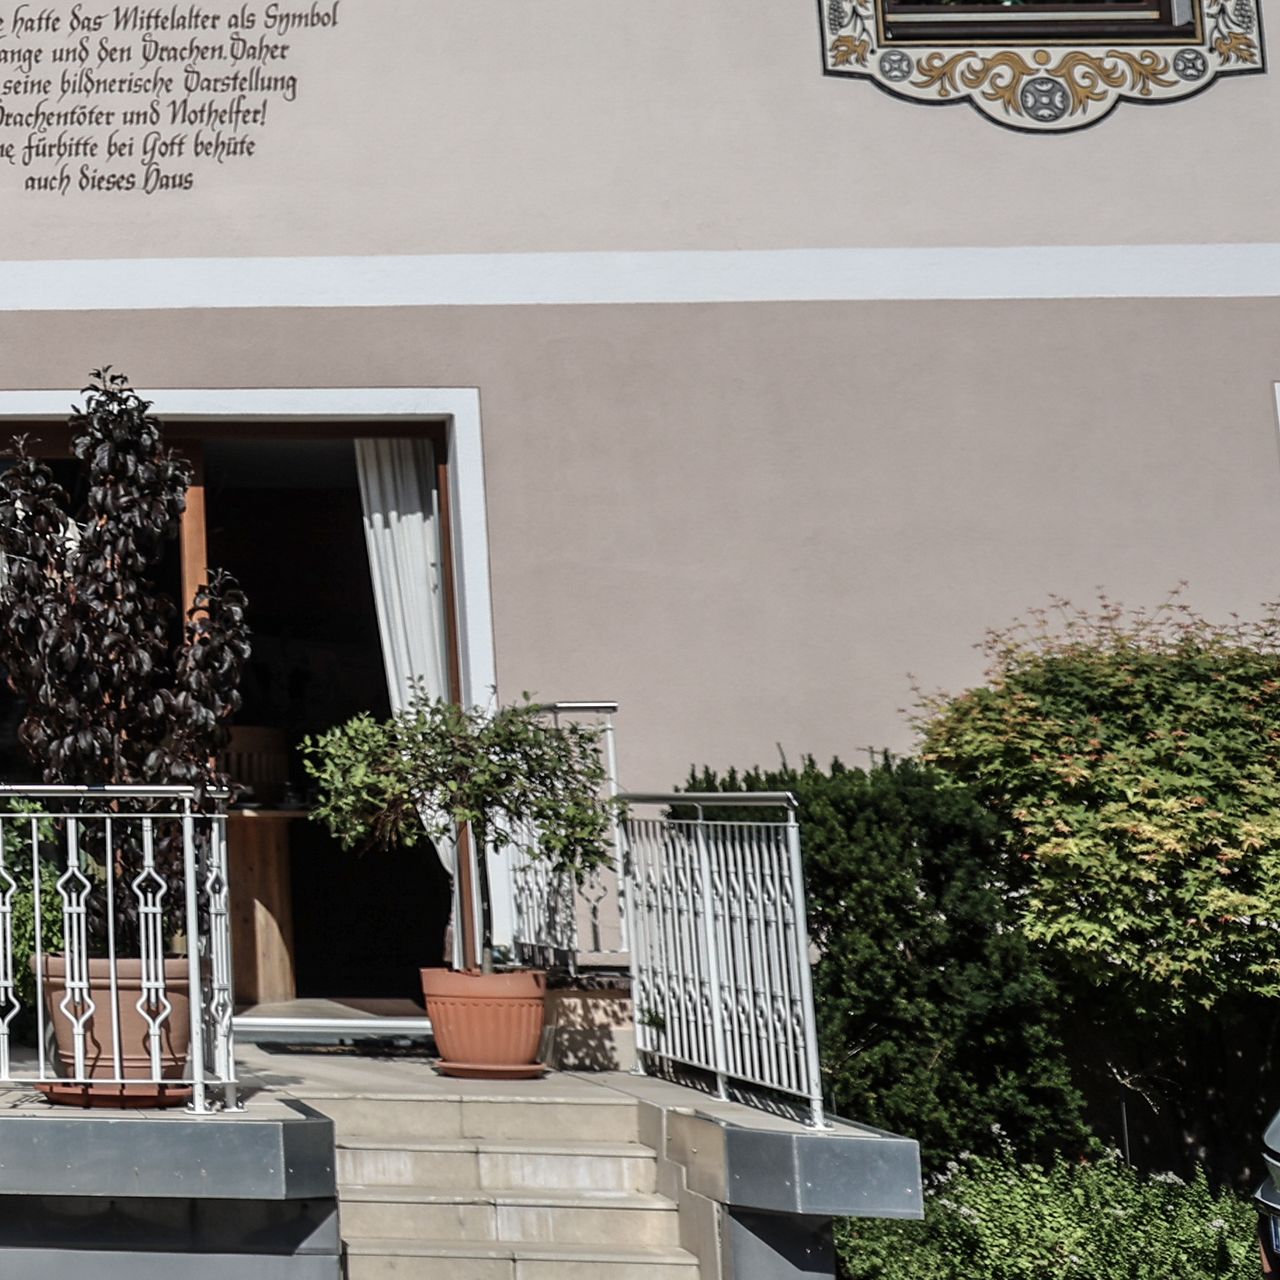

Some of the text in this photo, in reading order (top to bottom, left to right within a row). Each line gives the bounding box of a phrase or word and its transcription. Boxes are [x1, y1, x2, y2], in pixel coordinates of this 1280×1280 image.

[12, 4, 60, 38] hatte
[69, 4, 106, 37] das
[113, 4, 220, 30] Mittelalter
[227, 3, 256, 29] als
[264, 0, 340, 35] Symbol
[52, 36, 89, 67] und
[97, 37, 132, 68] den
[1, 75, 51, 95] seine
[57, 66, 173, 102] bildnerische
[184, 64, 297, 101] Darstellung
[122, 100, 160, 125] und
[167, 95, 267, 132] Nothelfer!
[106, 130, 133, 162] bei
[141, 131, 187, 166] Gott
[194, 130, 256, 163] behüte
[25, 162, 193, 195] auch dieses Haus
